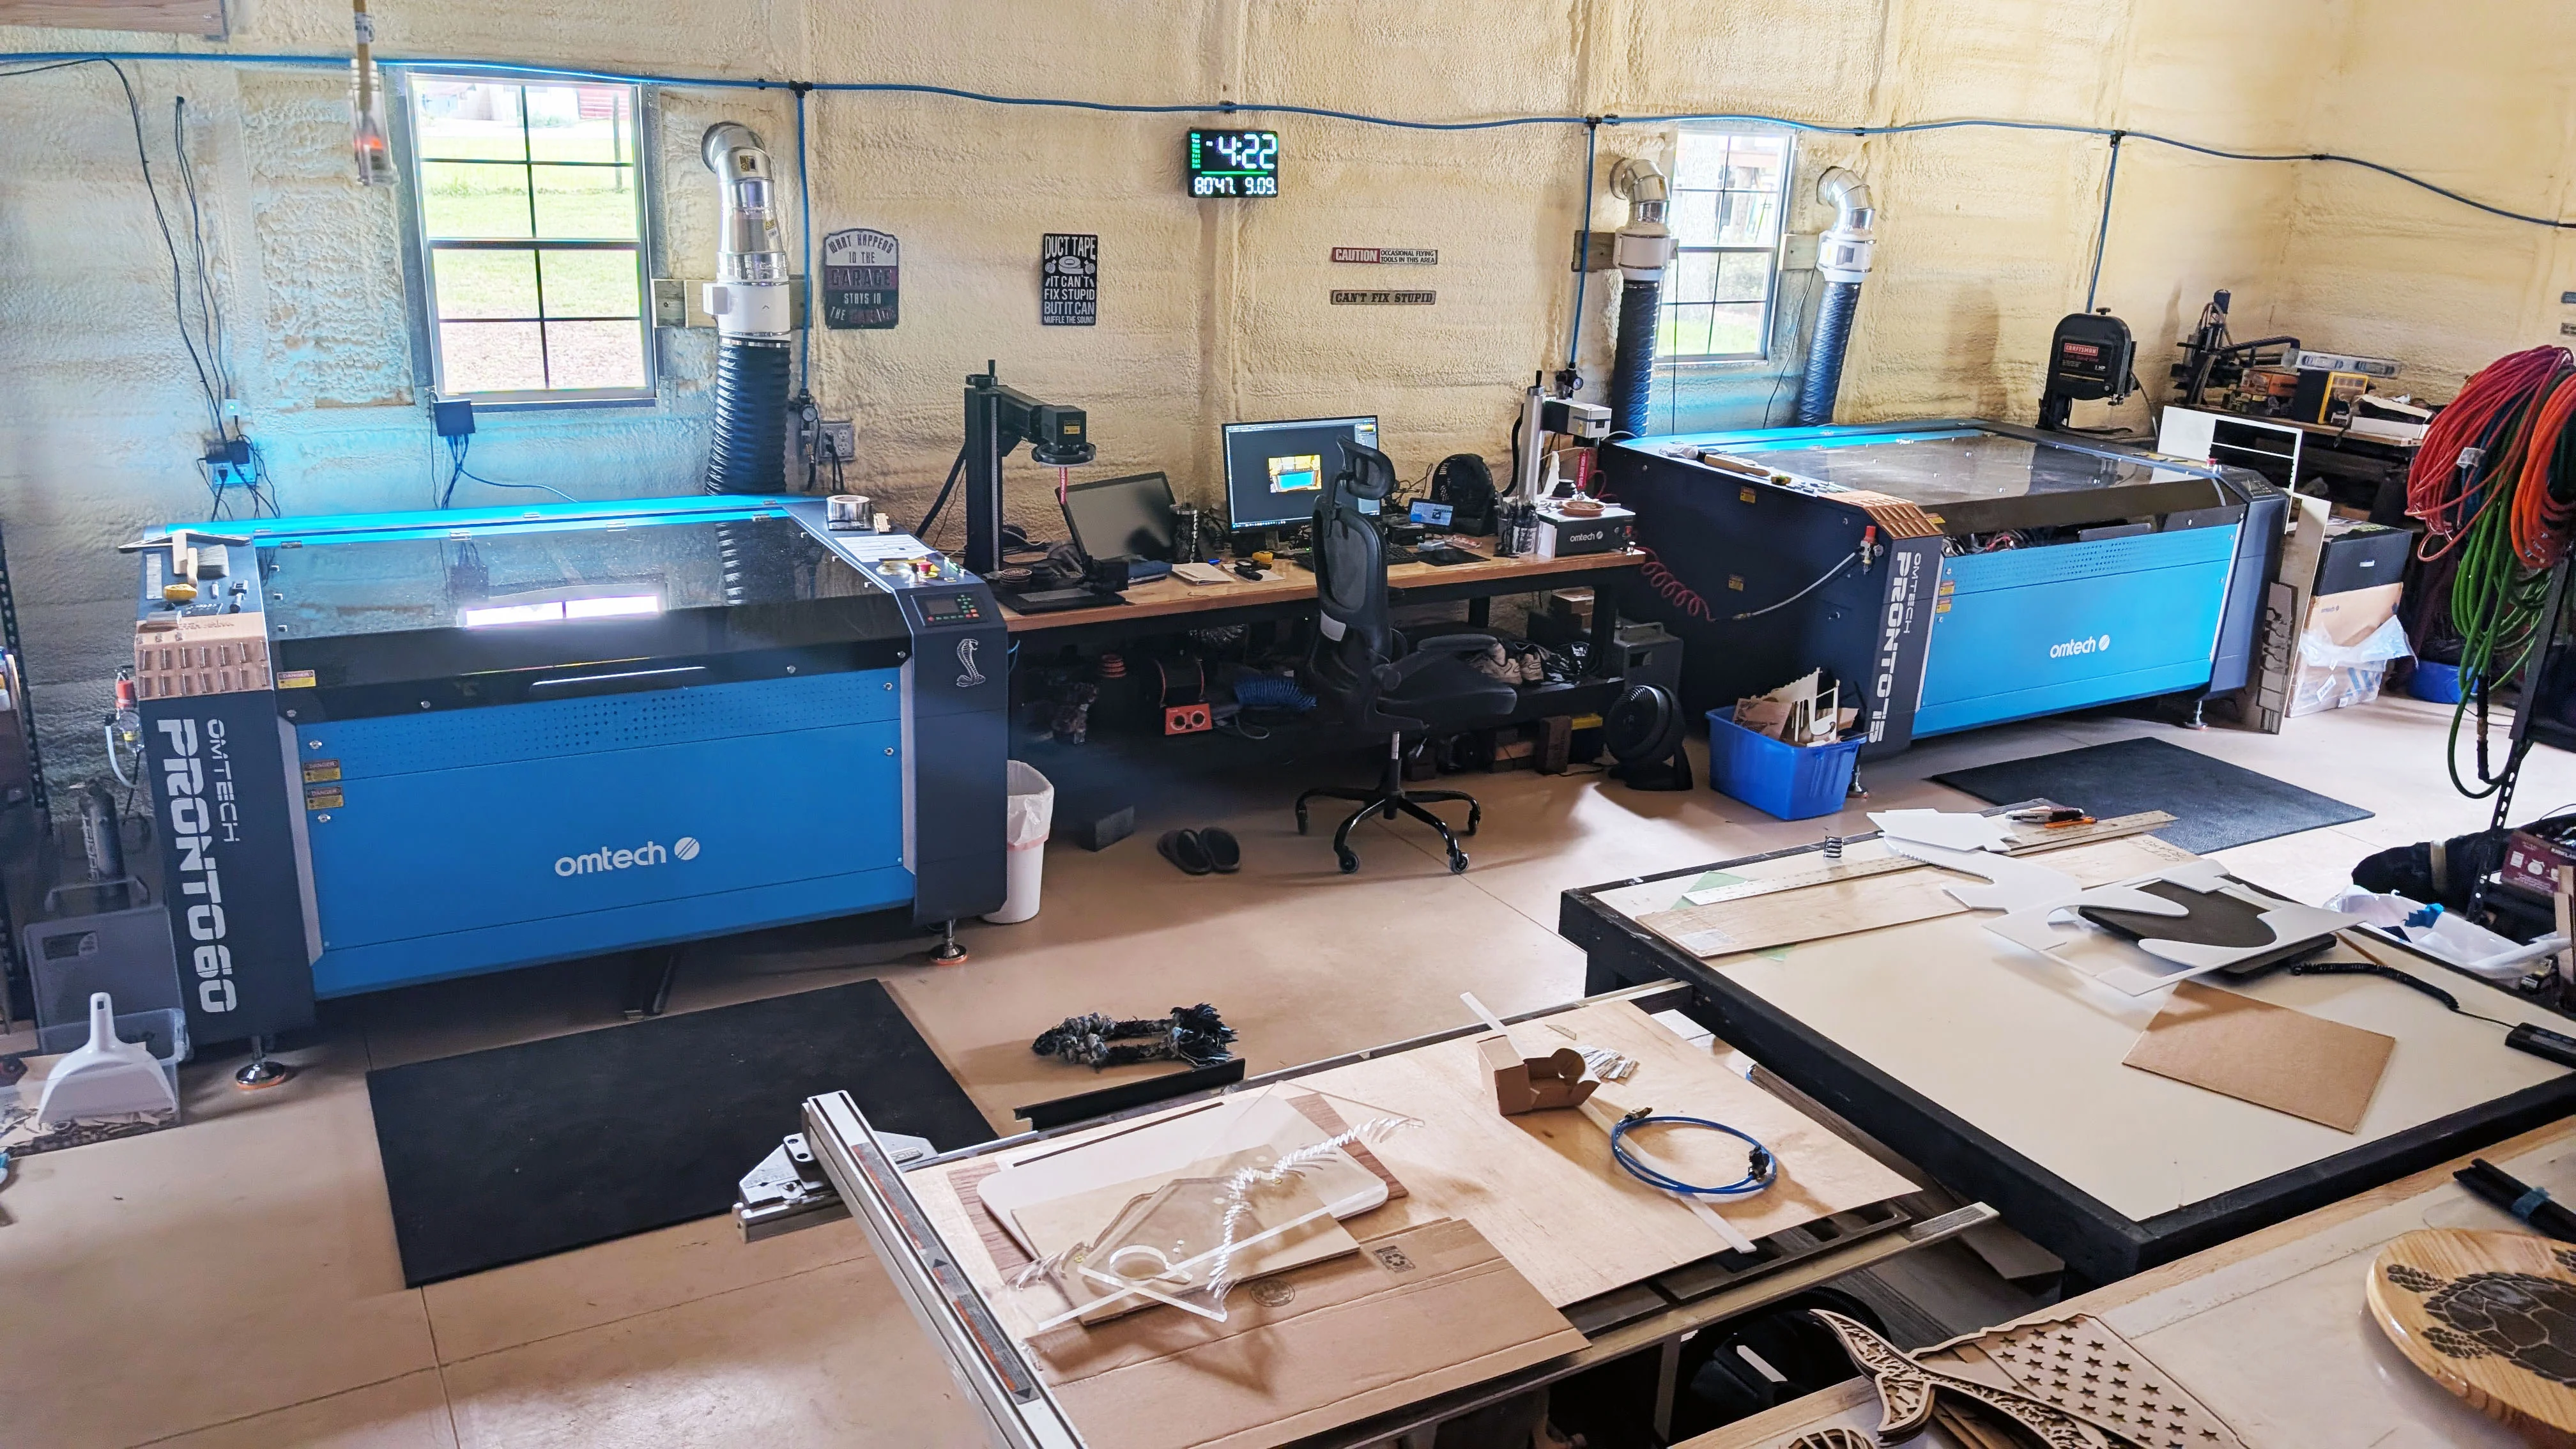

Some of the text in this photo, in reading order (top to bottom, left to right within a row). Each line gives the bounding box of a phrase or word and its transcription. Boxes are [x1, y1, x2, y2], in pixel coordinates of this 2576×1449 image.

[1218, 134, 1277, 169] 4:22
[828, 233, 894, 254] WHAT HAPPENS
[1045, 236, 1096, 261] DUCT TAPE
[861, 252, 875, 264] THE
[1335, 249, 1379, 261] CAUTION
[831, 268, 891, 287] GARAGE
[1050, 274, 1090, 288] IT CAN'T
[844, 293, 869, 304] STAYS
[1044, 288, 1095, 300] FIX STUPID
[1335, 293, 1433, 303] CAN'T FIX STUPID
[831, 306, 846, 321] THE
[1044, 301, 1095, 315] BUT IT CAN
[1044, 316, 1094, 324] MUFFLE THE SOUND
[2066, 344, 2097, 353] CRAFTSMAN
[1570, 532, 1595, 542] omtech
[1903, 552, 1921, 634] OMTECH
[2050, 636, 2096, 659] omtech
[207, 719, 240, 842] OMTECH
[555, 841, 666, 877] omtech
